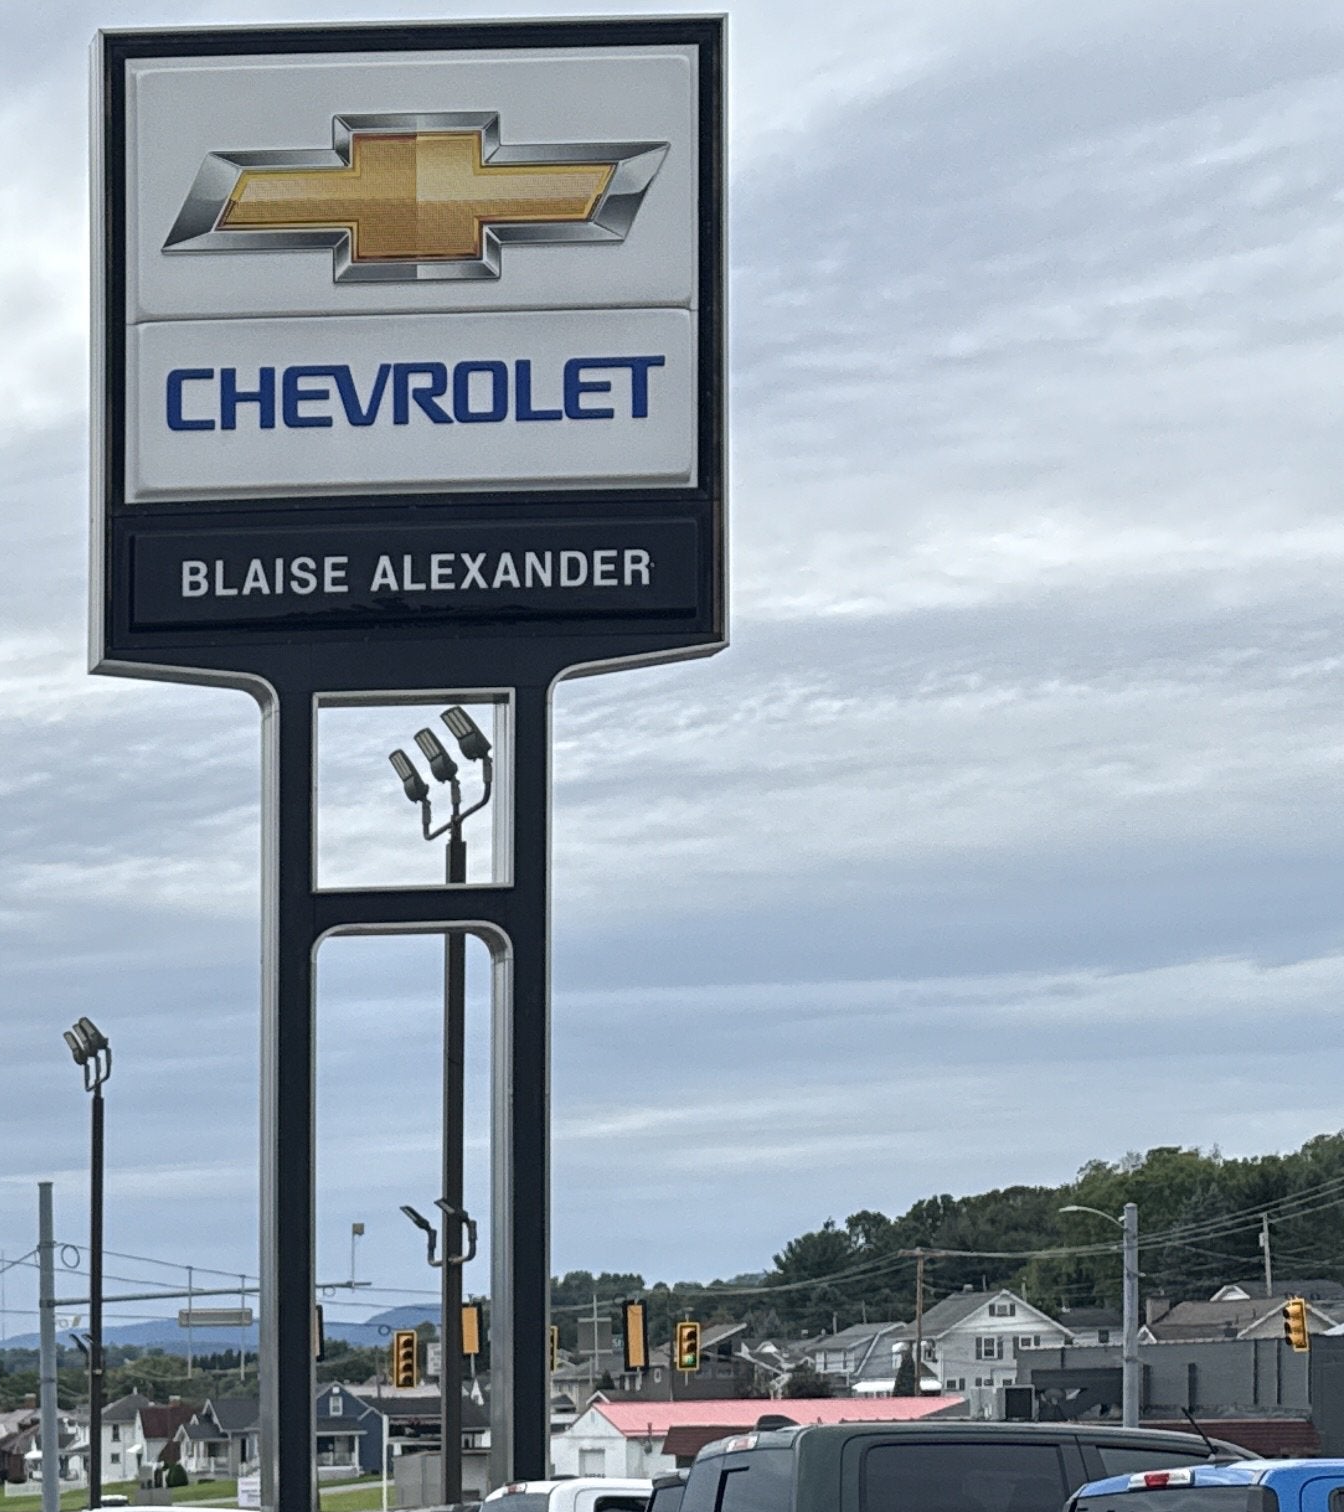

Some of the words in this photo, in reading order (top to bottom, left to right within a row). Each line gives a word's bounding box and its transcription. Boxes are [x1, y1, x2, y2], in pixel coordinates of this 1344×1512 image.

[165, 354, 666, 432] CHEVROLET
[180, 555, 349, 599] BLAISE
[370, 548, 653, 594] ALEXANDER
